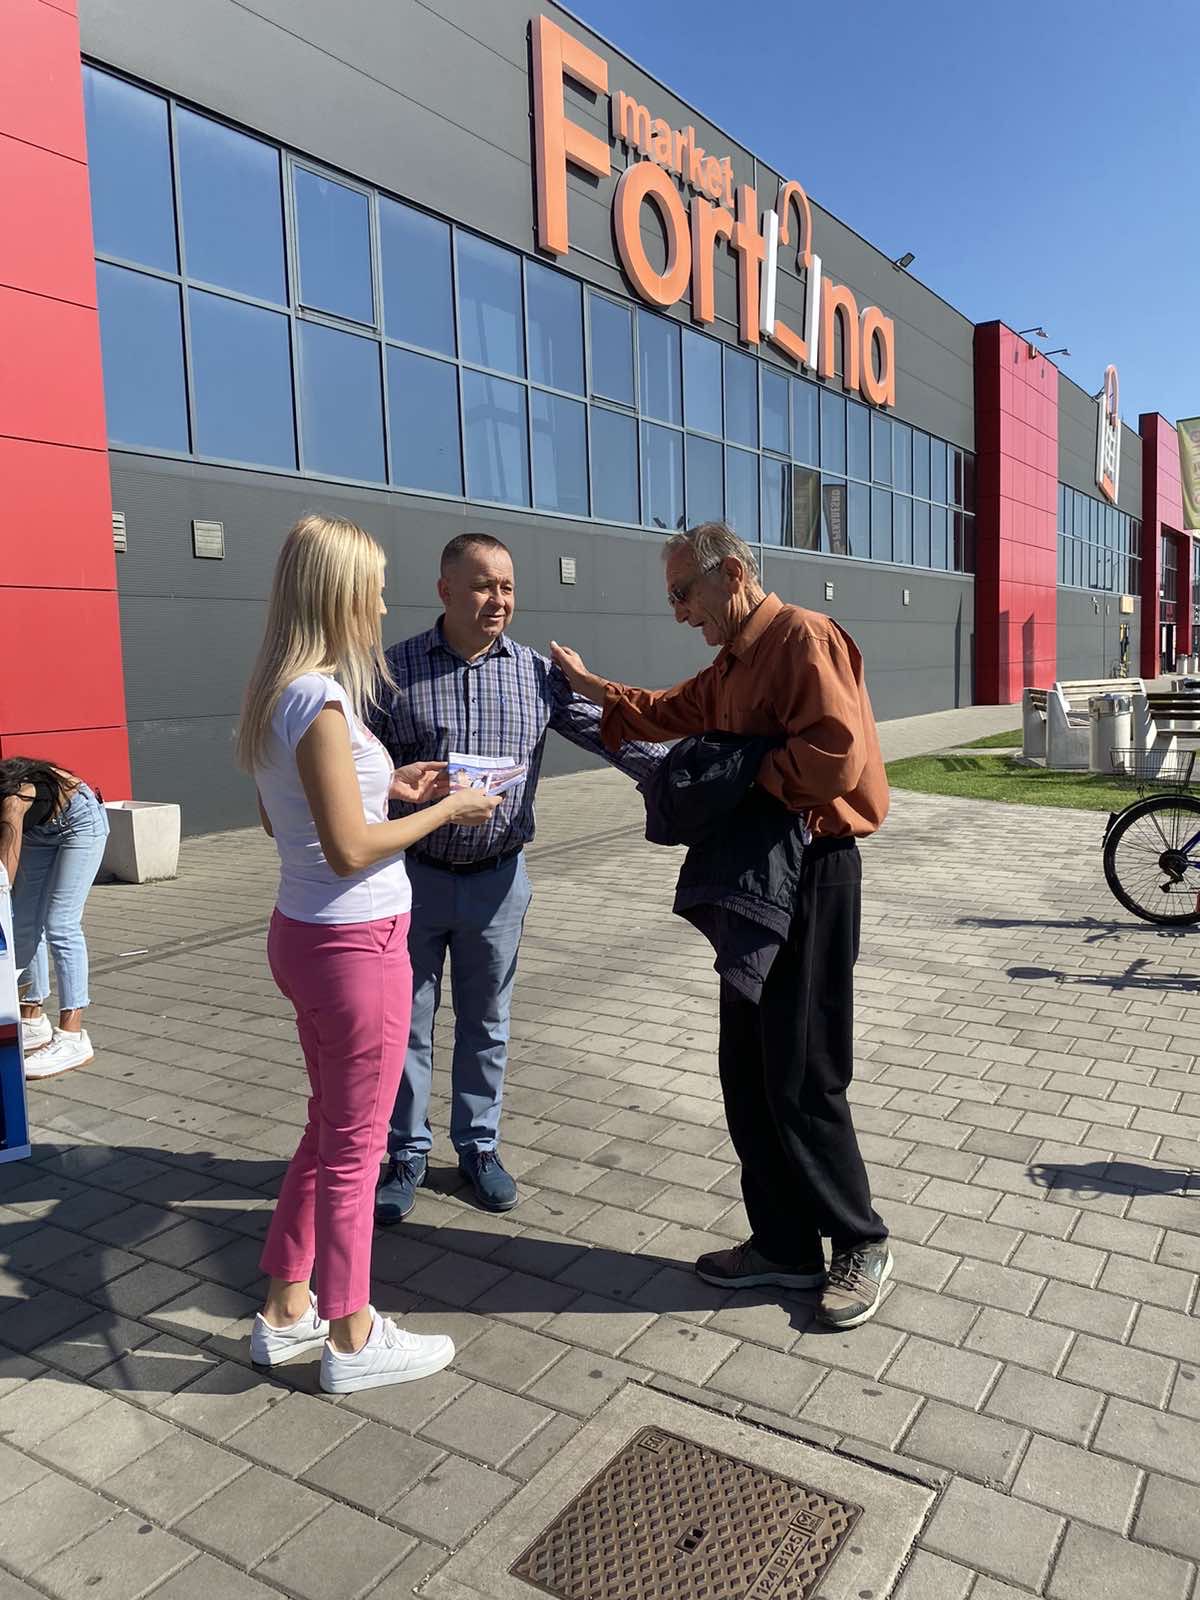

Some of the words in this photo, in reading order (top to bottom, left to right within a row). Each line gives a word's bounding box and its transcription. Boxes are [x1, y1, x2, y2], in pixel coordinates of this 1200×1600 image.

[612, 89, 734, 208] market
[757, 1571, 779, 1594] 124
[774, 1534, 803, 1568] B125
